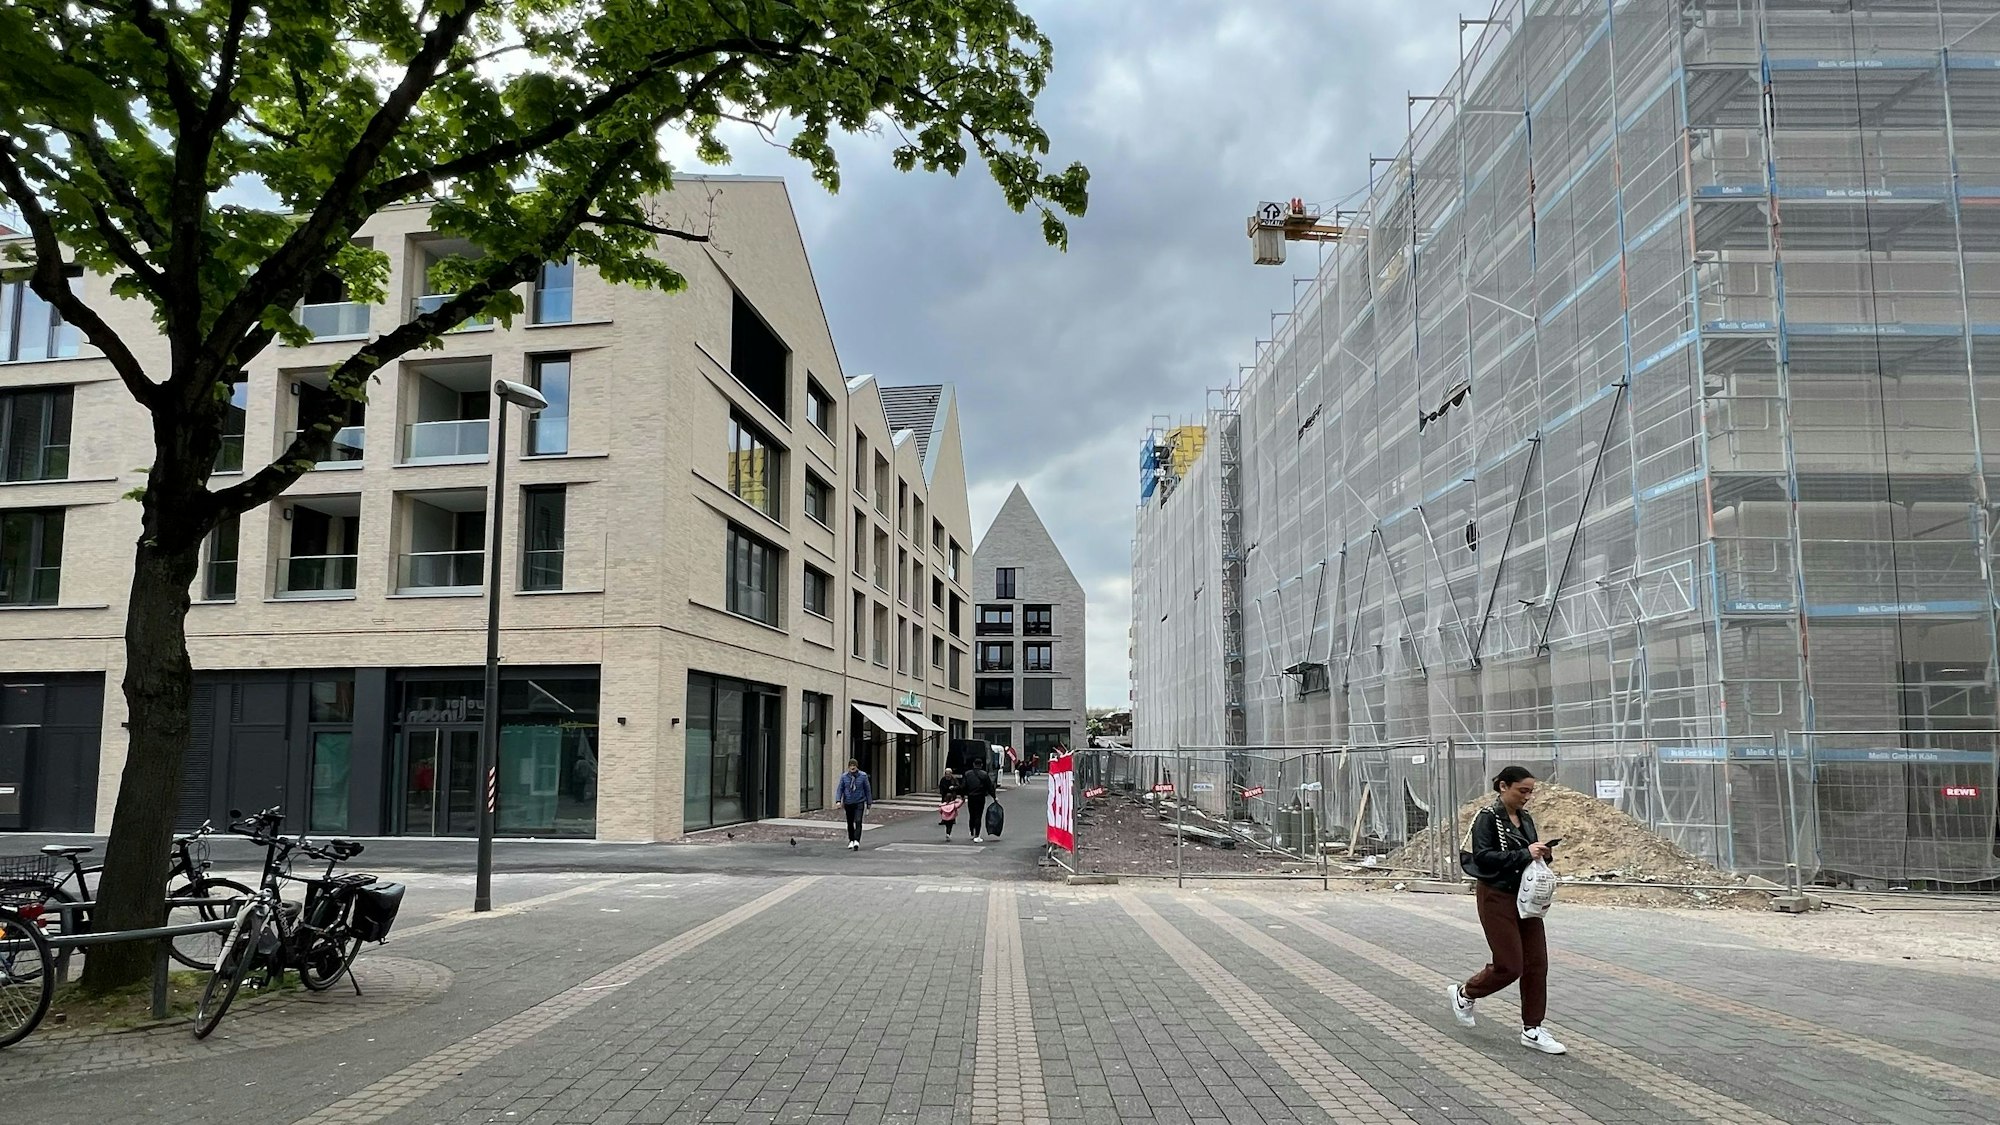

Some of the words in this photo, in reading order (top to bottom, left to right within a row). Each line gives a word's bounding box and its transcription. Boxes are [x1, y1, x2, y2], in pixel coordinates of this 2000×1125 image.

[1718, 322, 1739, 330] Melik
[1741, 322, 1766, 330] GmbH
[1735, 602, 1757, 610] Melik
[1757, 602, 1782, 610] GmbH
[1857, 605, 1879, 613] Melik
[1880, 604, 1906, 612] GmbH
[1745, 748, 1768, 756] Melik
[1868, 752, 1890, 760] Melik
[1891, 752, 1918, 760] GmbH
[1918, 752, 1938, 761] Köln
[1244, 787, 1262, 798] REWE
[1946, 788, 1977, 796] REWE
